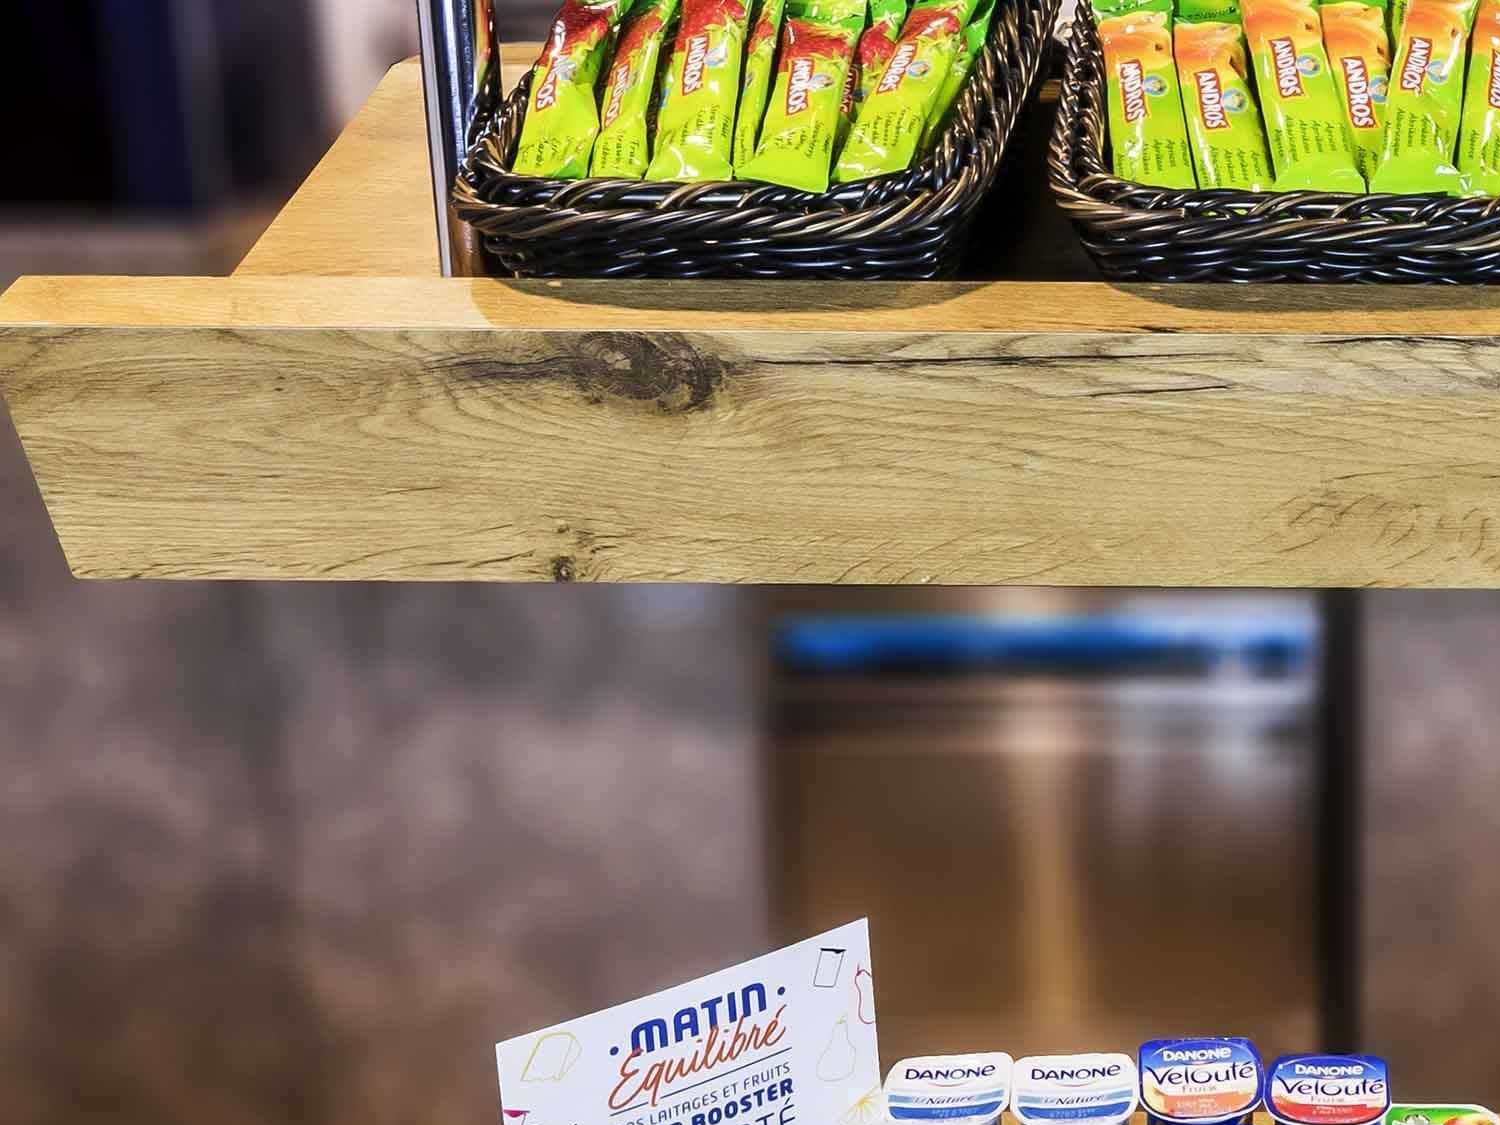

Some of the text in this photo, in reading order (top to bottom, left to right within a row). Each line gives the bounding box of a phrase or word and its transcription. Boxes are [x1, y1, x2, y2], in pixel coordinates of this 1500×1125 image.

[1121, 63, 1147, 121] ANDROS
[1271, 40, 1300, 97] ANDROS
[1402, 38, 1430, 90] ANDROS
[1198, 72, 1226, 128] ANDROS
[1344, 59, 1376, 127] ANDROS
[631, 983, 767, 1056] MATIN
[650, 1091, 718, 1124] LAITAGES
[723, 1083, 738, 1097] ET
[744, 1062, 790, 1090] FRUITS
[1146, 1060, 1254, 1086] Velouté
[1278, 1076, 1384, 1096] Velouté
